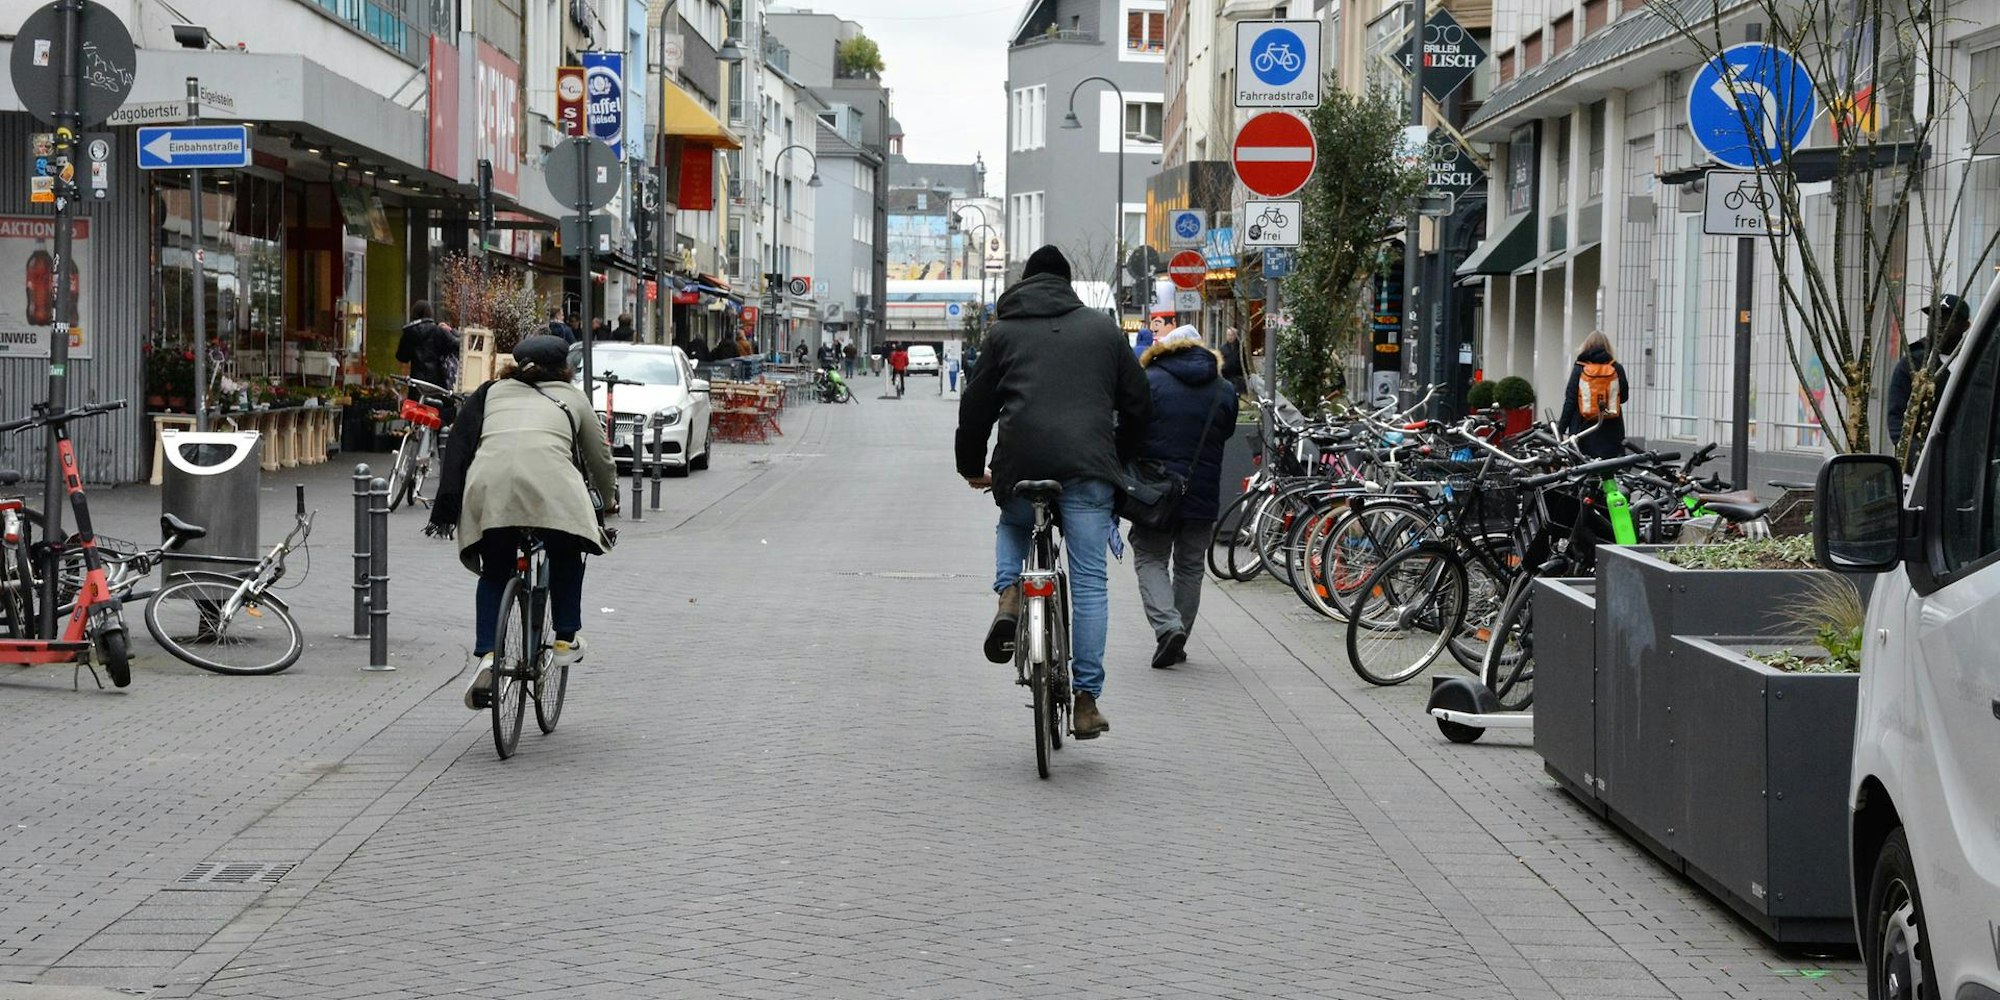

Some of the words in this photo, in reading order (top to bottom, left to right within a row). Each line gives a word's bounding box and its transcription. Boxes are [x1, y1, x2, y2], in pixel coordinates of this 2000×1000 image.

[1424, 44, 1460, 53] BRILLEN
[201, 87, 234, 107] Eigelstein
[1240, 91, 1314, 100] Fahrradstraße
[111, 106, 181, 122] Dagobertstr.
[478, 60, 516, 174] REWE
[169, 142, 240, 152] Einbahnstraße
[1735, 214, 1761, 228] frei
[1263, 231, 1281, 241] frei
[0, 333, 37, 344] INWEG
